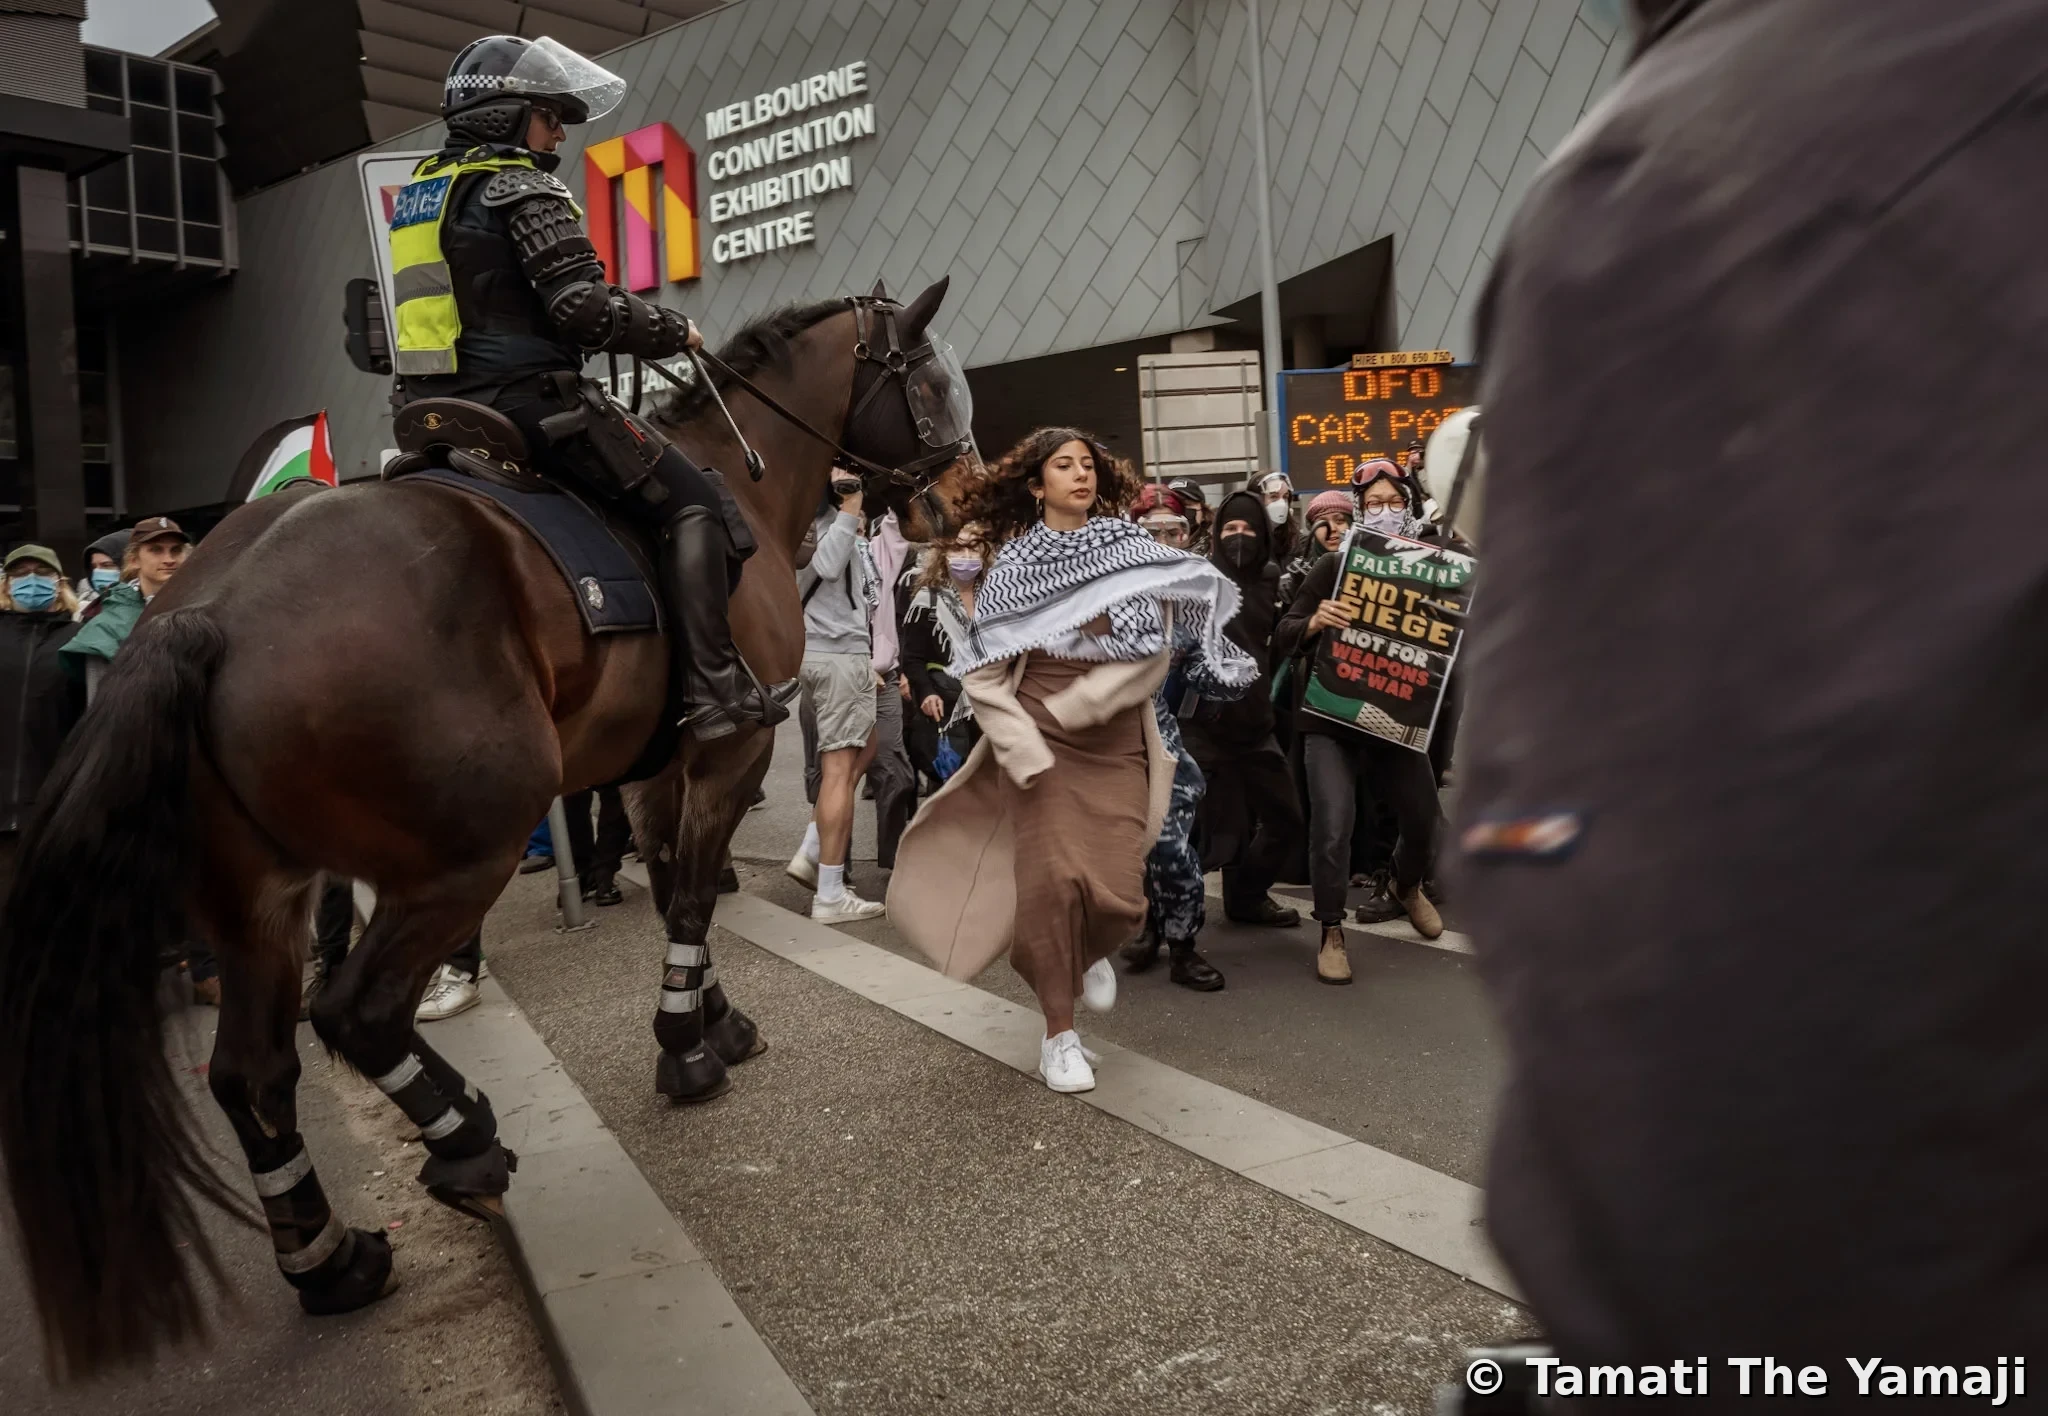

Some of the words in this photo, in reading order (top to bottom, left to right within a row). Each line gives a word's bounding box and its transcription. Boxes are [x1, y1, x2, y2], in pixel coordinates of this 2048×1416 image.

[706, 60, 868, 140] MELBOURNE
[708, 103, 875, 180] CONVENTION
[710, 156, 852, 223] EXHIBITION
[712, 210, 815, 263] CENTRE
[1355, 355, 1377, 367] HIRE
[1380, 356, 1385, 364] 1
[1343, 368, 1440, 401] DFO
[1292, 411, 1372, 446] CAR
[1352, 553, 1461, 584] PALESTINE
[1342, 573, 1398, 606] END
[1331, 641, 1429, 687] WEAPONS
[1340, 628, 1386, 653] NOT
[1387, 641, 1429, 668] FOR
[1336, 662, 1364, 682] OF
[1367, 673, 1413, 700] WAR
